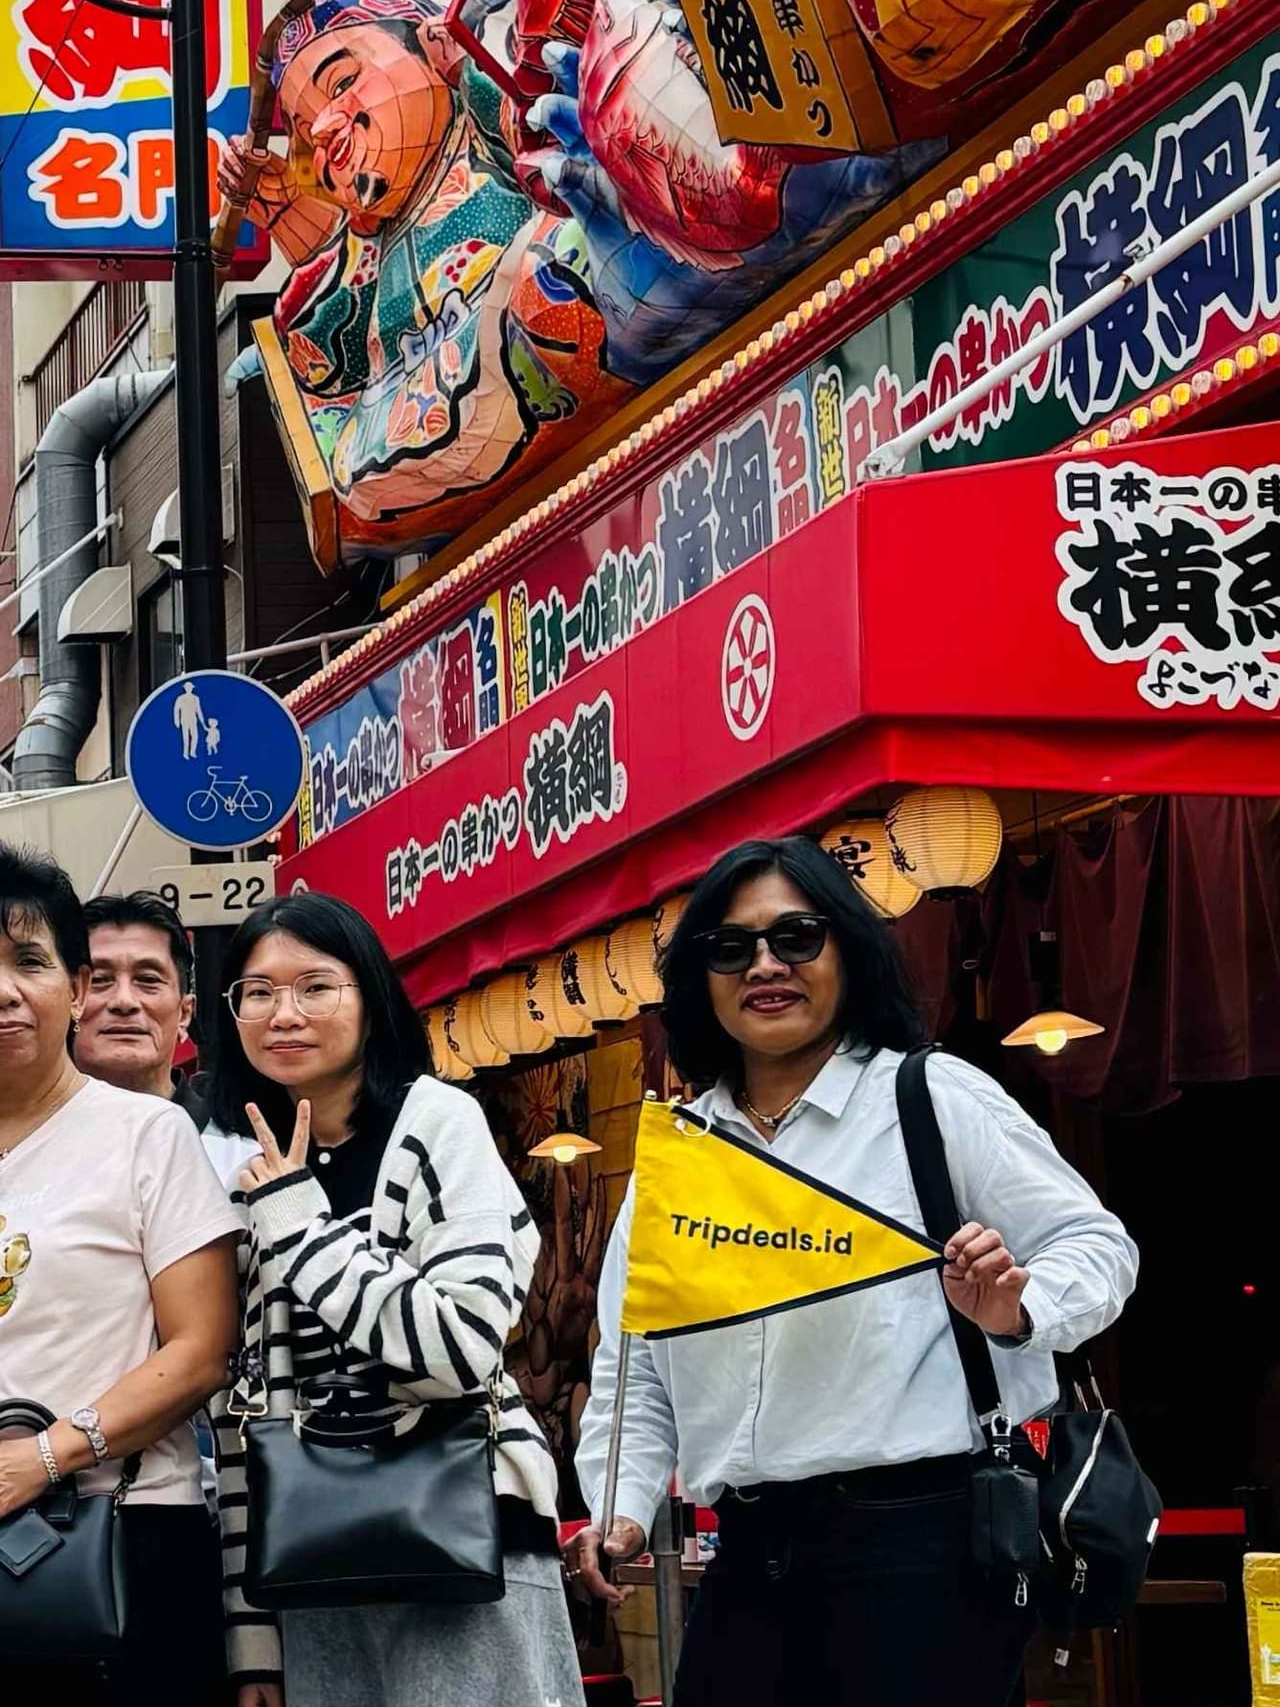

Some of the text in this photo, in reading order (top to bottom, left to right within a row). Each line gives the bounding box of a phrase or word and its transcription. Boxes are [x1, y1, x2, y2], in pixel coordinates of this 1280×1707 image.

[1056, 94, 1255, 414] 横綱
[388, 700, 611, 907] 日本一の串かつ 横綱
[670, 1213, 853, 1256] Tripdeals.id
